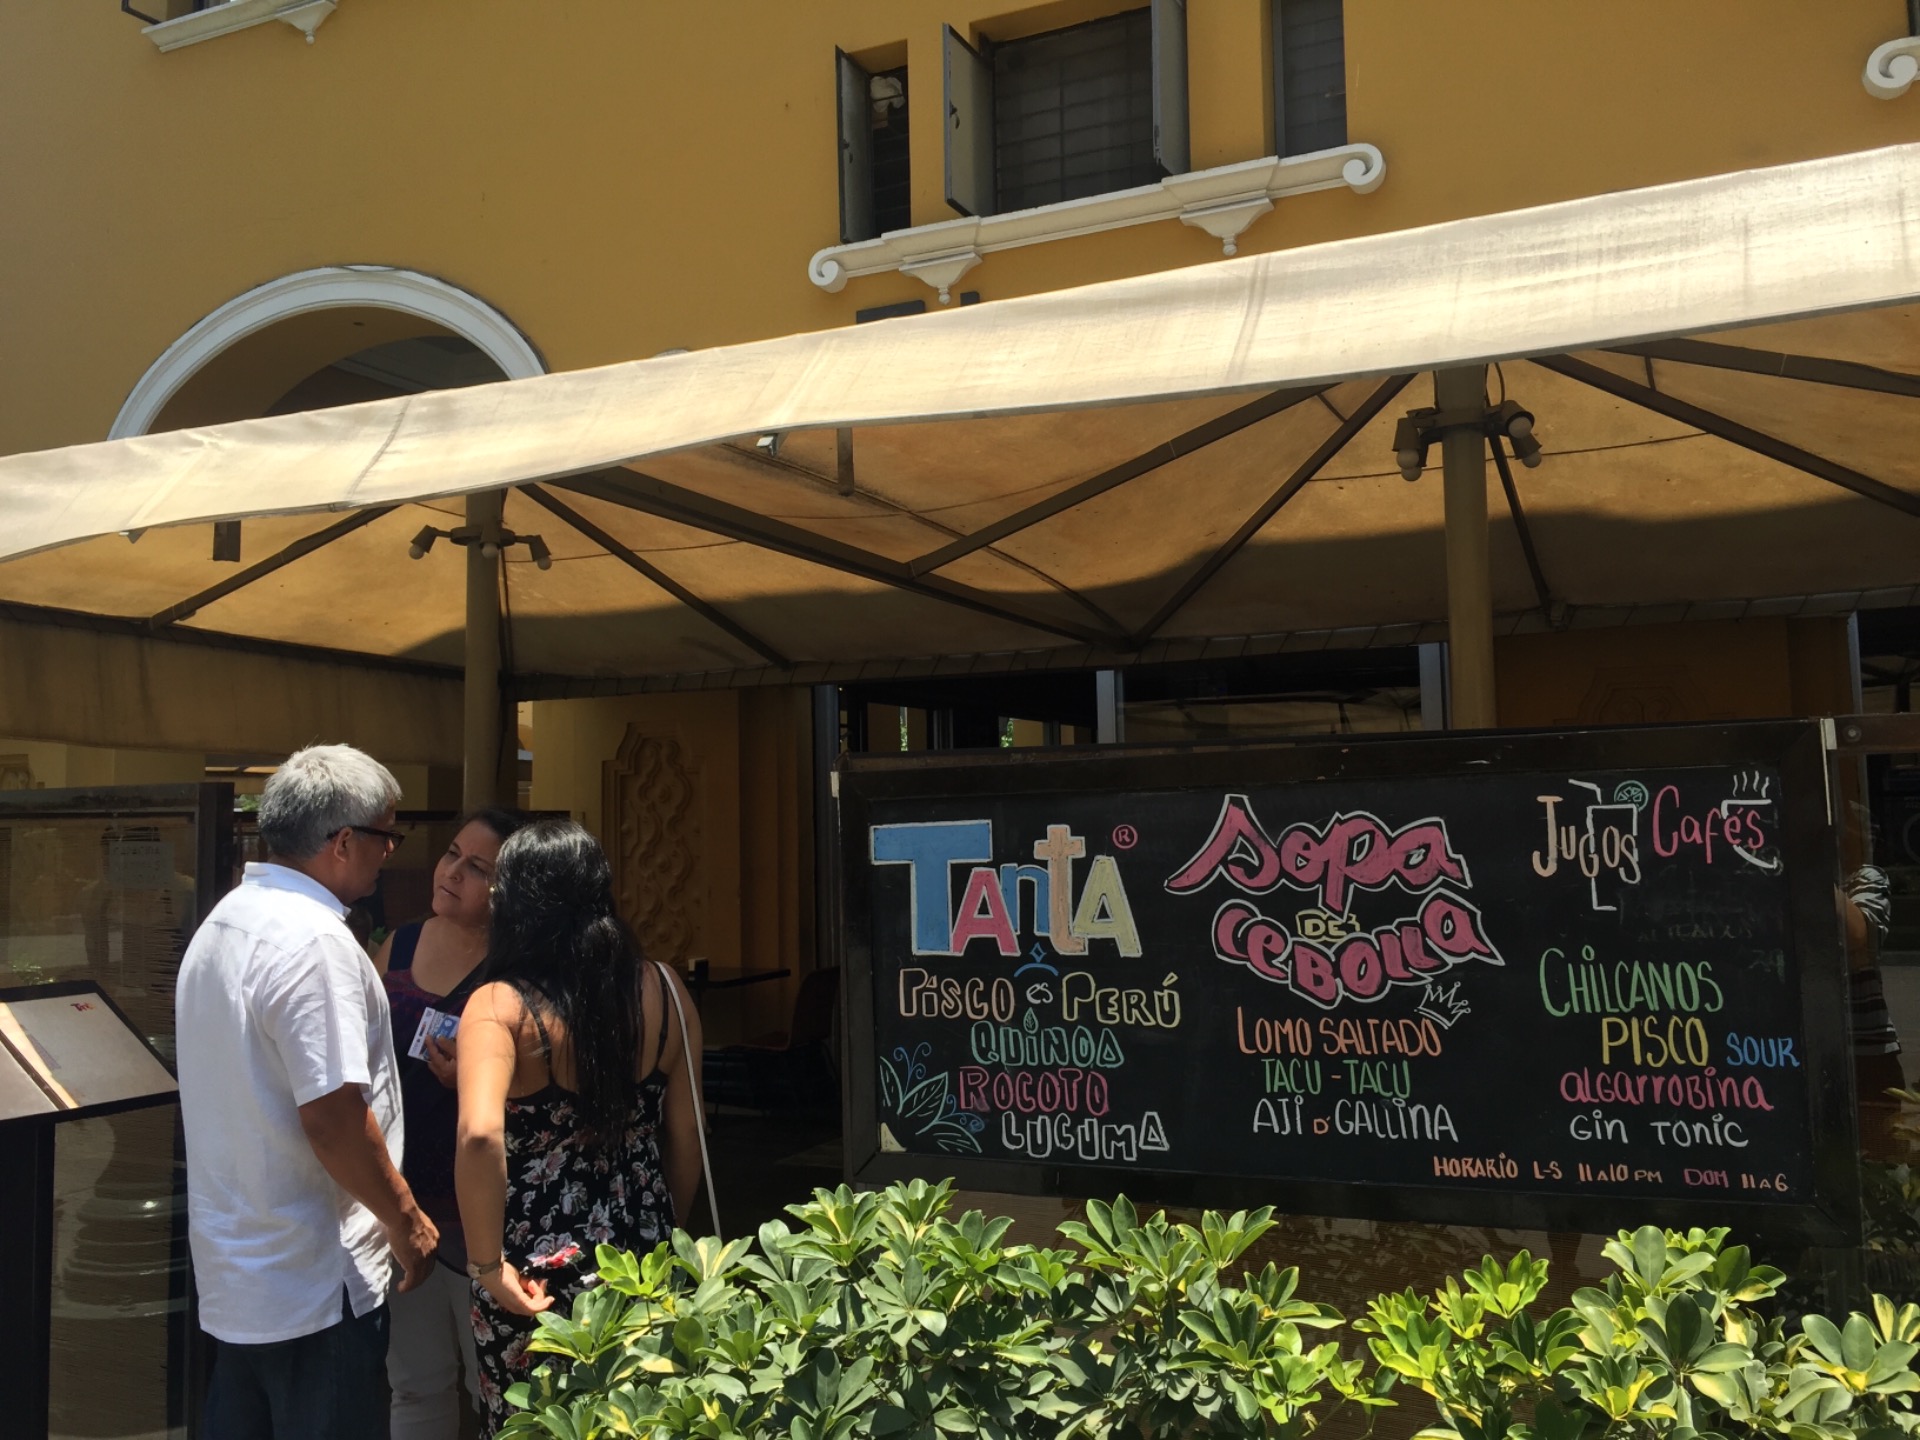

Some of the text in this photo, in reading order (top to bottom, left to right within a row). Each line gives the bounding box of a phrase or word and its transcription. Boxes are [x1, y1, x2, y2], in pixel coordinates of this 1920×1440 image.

[1653, 785, 1764, 863] Cafés
[1062, 971, 1180, 1028] PERÚ
[1237, 1006, 1443, 1057] LOMO SALTADO
[1602, 1017, 1799, 1067] PISCO SOUR
[958, 1066, 1110, 1116] ROCOTO
[1001, 1111, 1170, 1161] LUCUMA
[1634, 1169, 1663, 1184] PM
[1683, 1168, 1730, 1188] DOM
